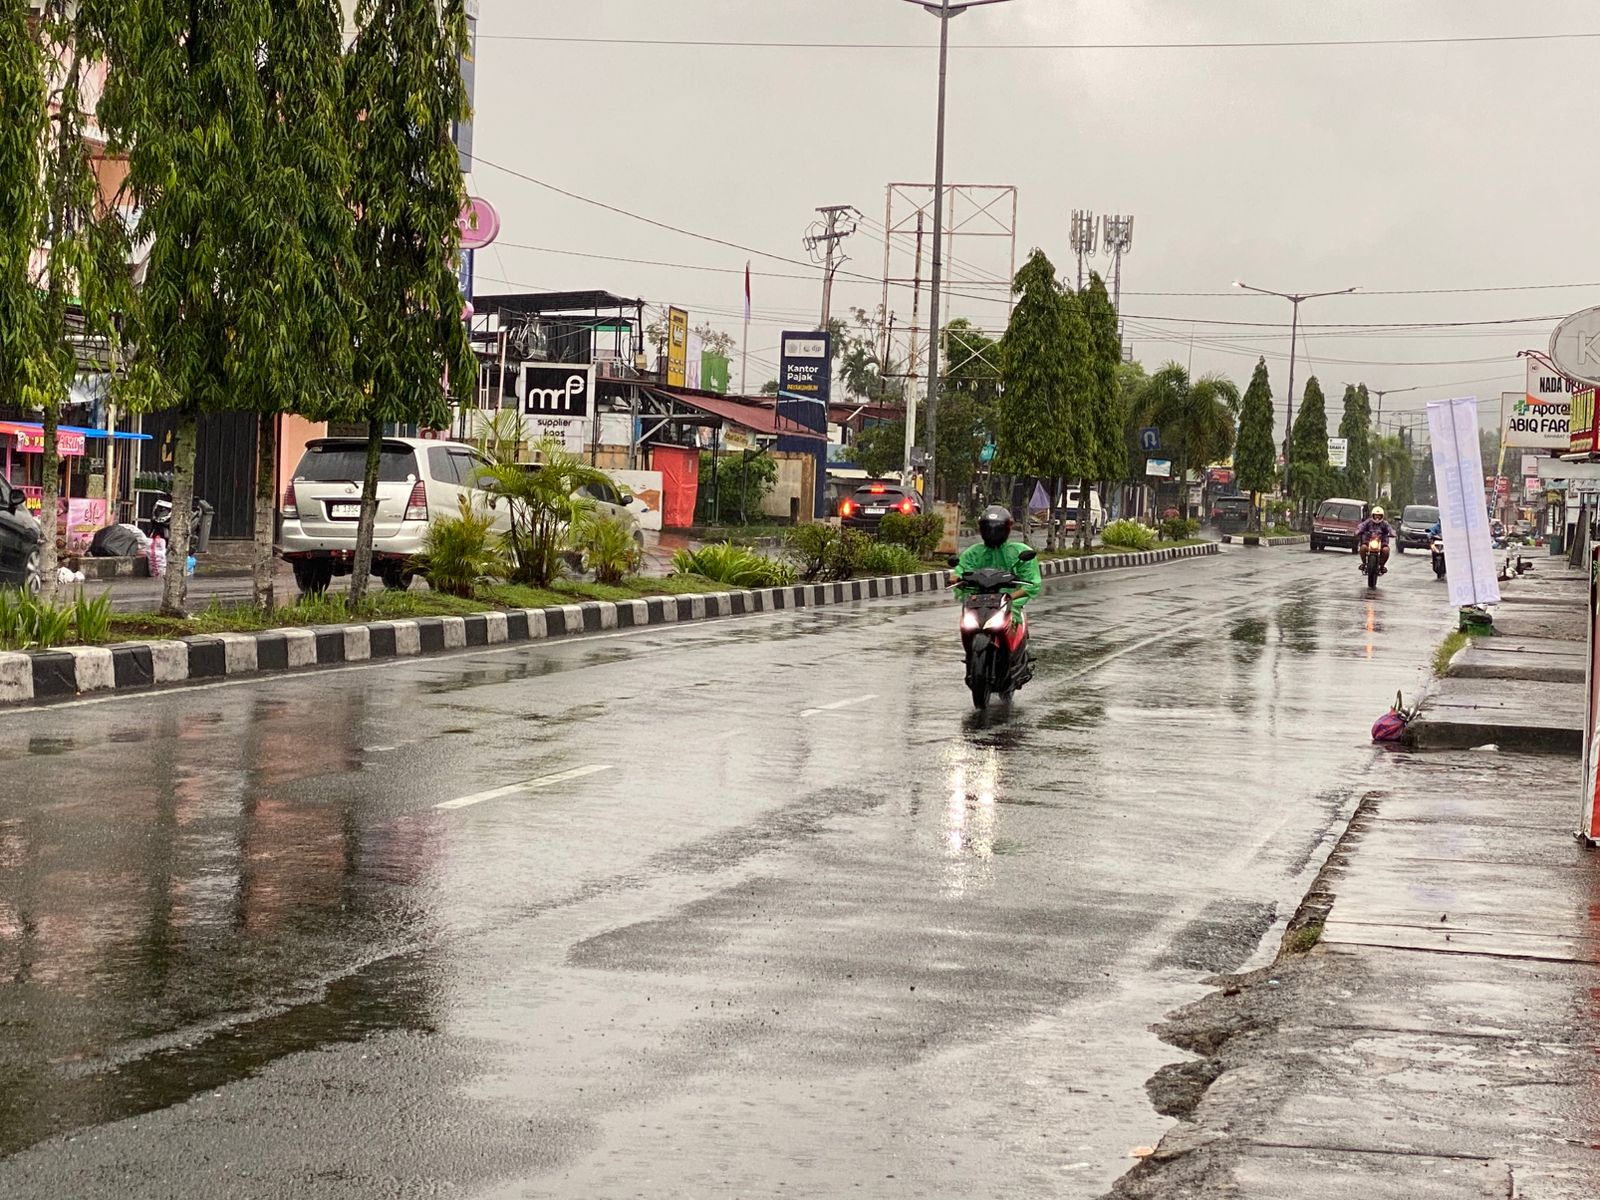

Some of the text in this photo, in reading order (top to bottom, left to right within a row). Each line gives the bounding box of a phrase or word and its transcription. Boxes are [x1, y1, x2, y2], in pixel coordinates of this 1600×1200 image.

[787, 364, 819, 373] Kantor
[787, 373, 813, 382] Pajak
[1539, 377, 1562, 393] NADA
[537, 418, 572, 428] supplier
